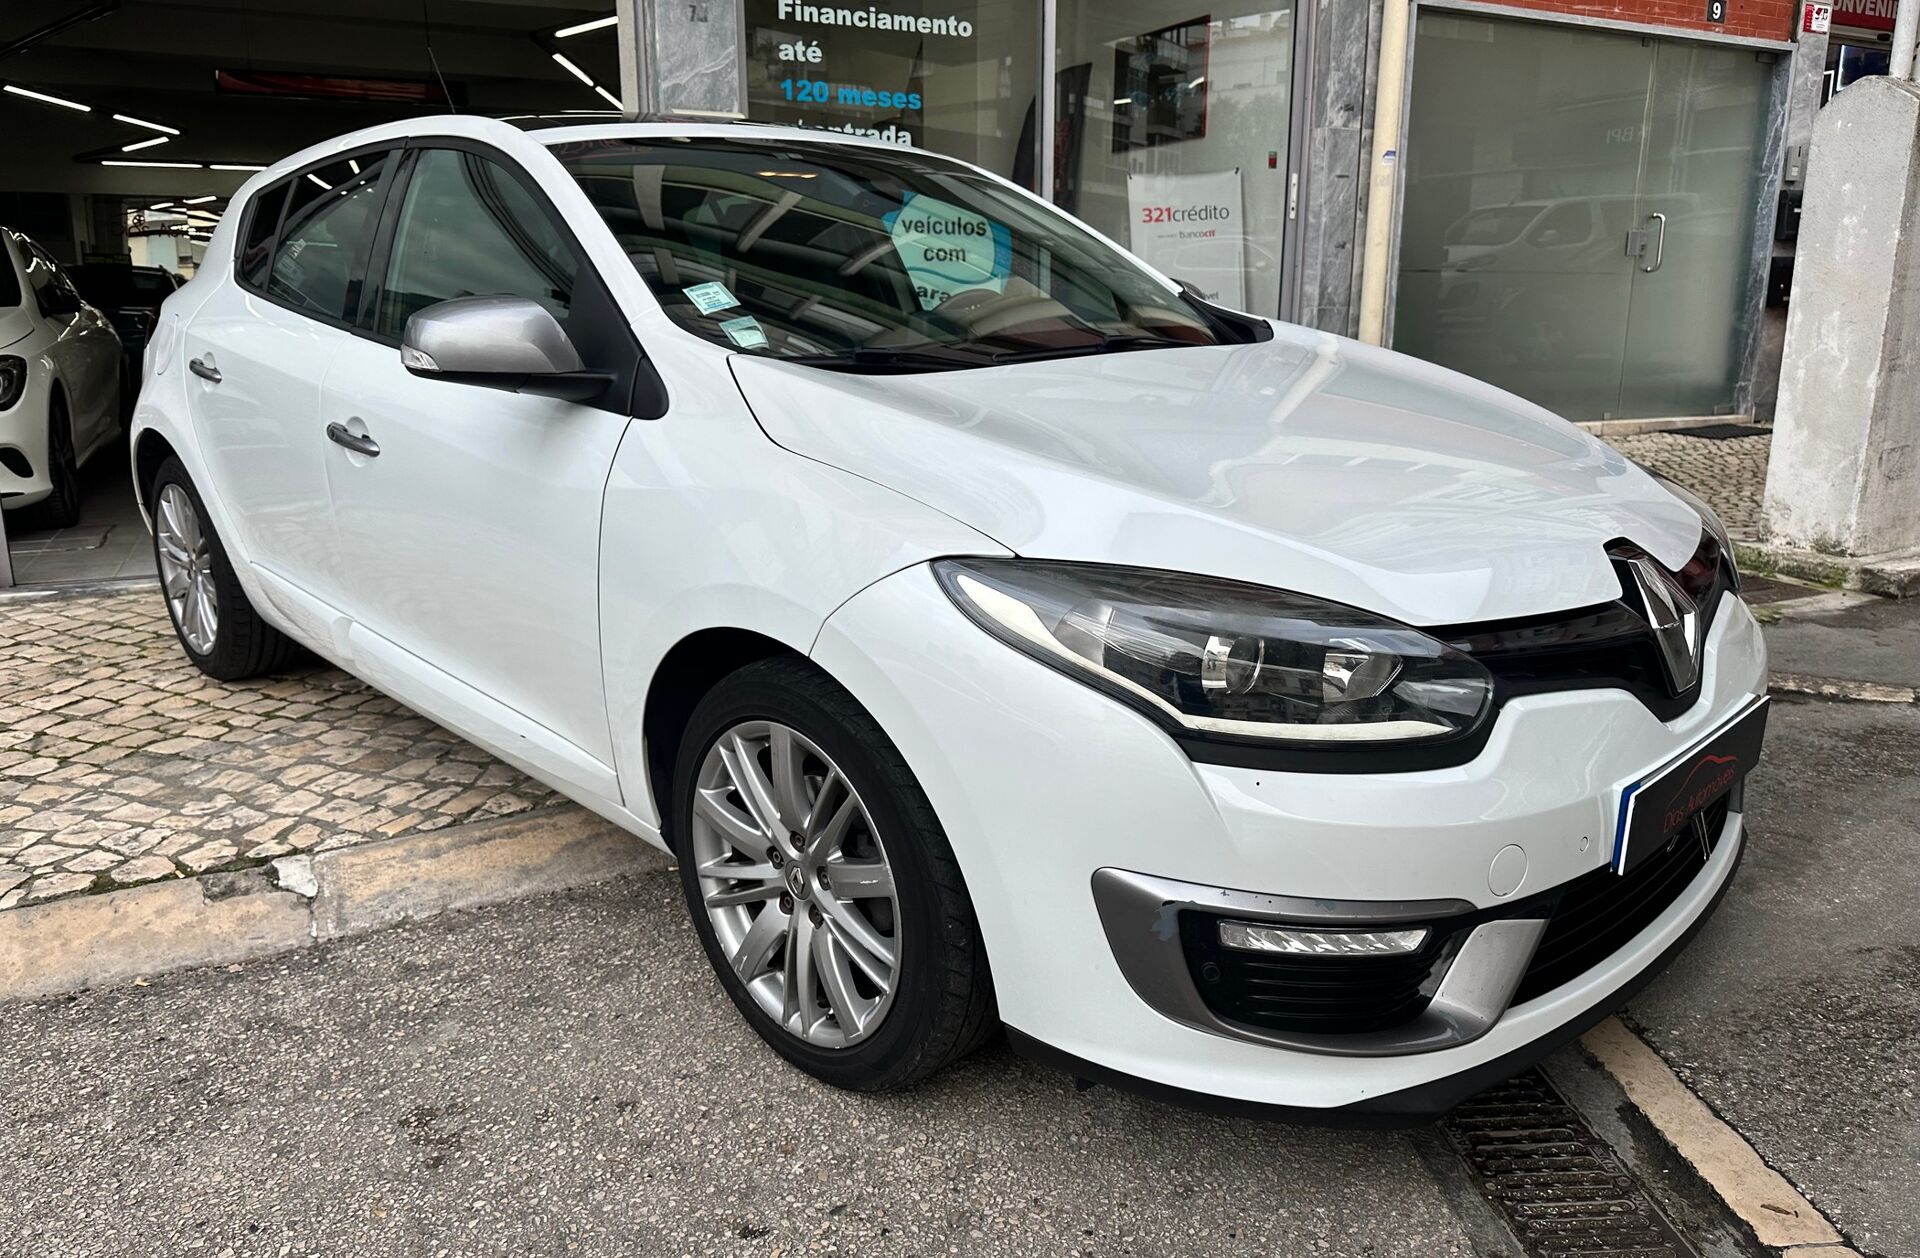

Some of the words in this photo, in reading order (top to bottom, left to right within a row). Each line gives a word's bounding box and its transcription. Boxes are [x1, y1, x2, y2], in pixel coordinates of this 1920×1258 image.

[777, 0, 973, 38] Financiamento
[1712, 2, 1722, 19] 9
[778, 40, 823, 63] até
[780, 78, 829, 103] 120
[837, 86, 922, 110] meses
[1142, 205, 1230, 223] 321crédito
[902, 216, 987, 236] veículos
[923, 248, 966, 262] com
